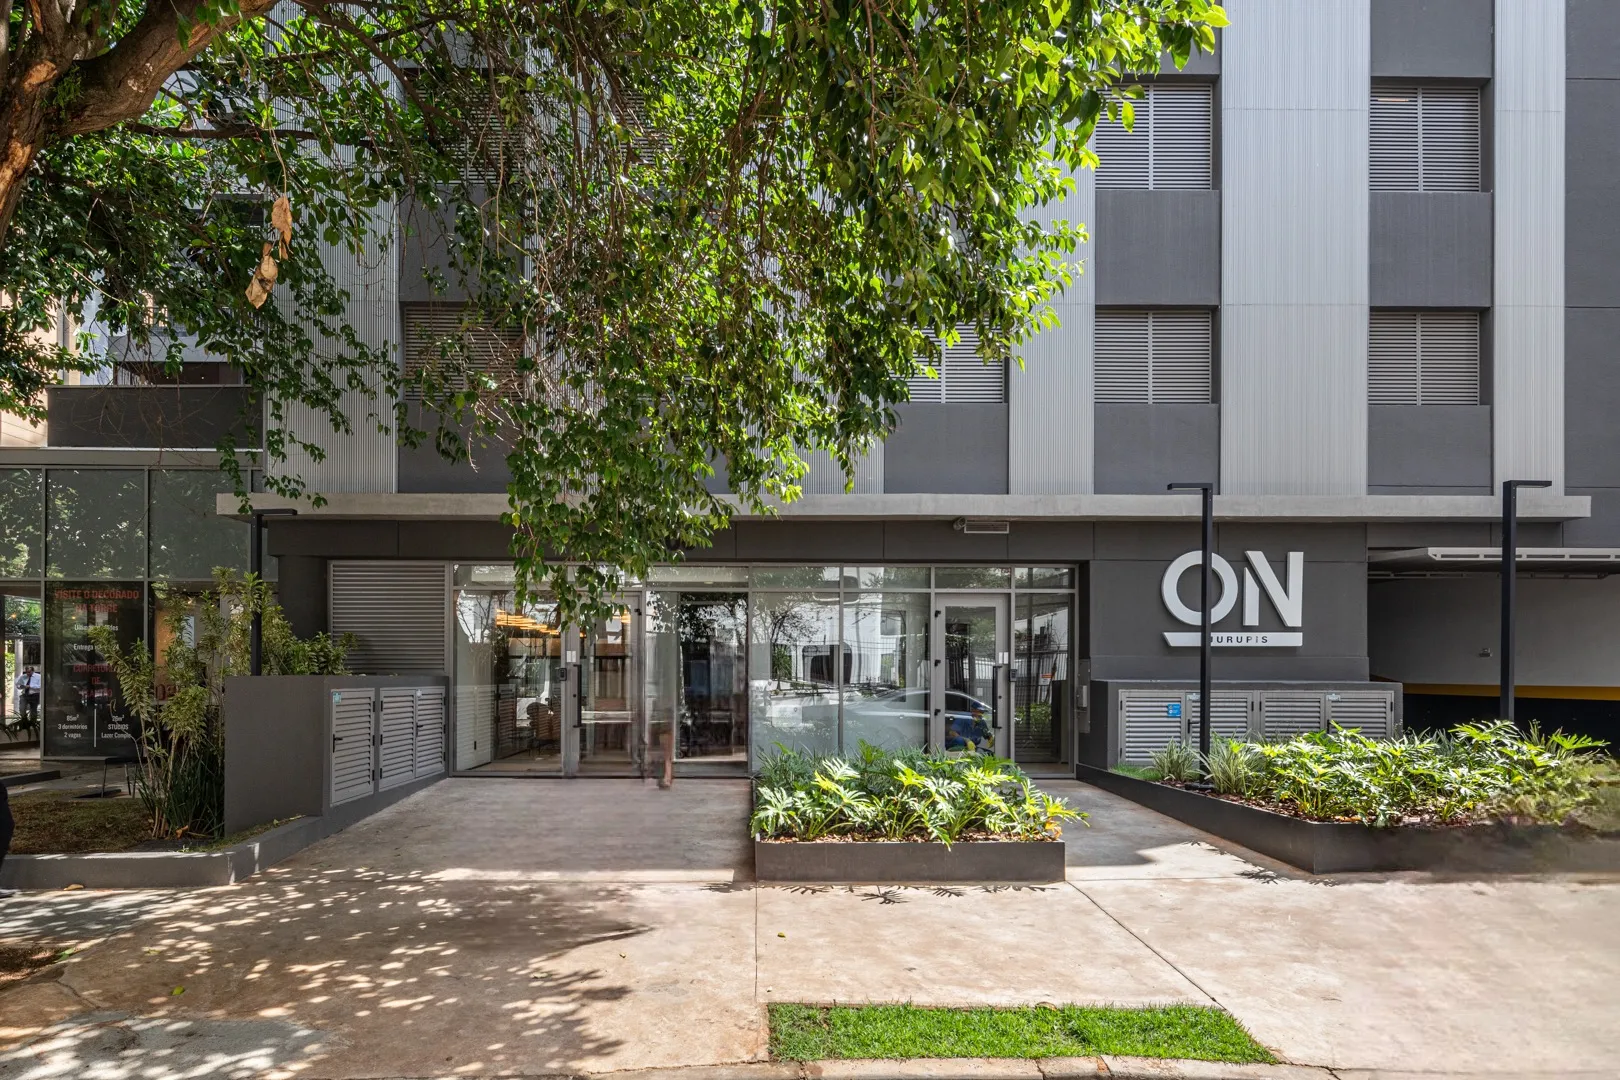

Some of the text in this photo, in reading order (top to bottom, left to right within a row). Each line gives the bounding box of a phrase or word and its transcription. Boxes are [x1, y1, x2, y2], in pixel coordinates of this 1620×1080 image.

[1161, 550, 1304, 627] ON
[84, 590, 90, 599] O
[92, 590, 139, 599] DECORADO
[73, 643, 93, 651] Entrega
